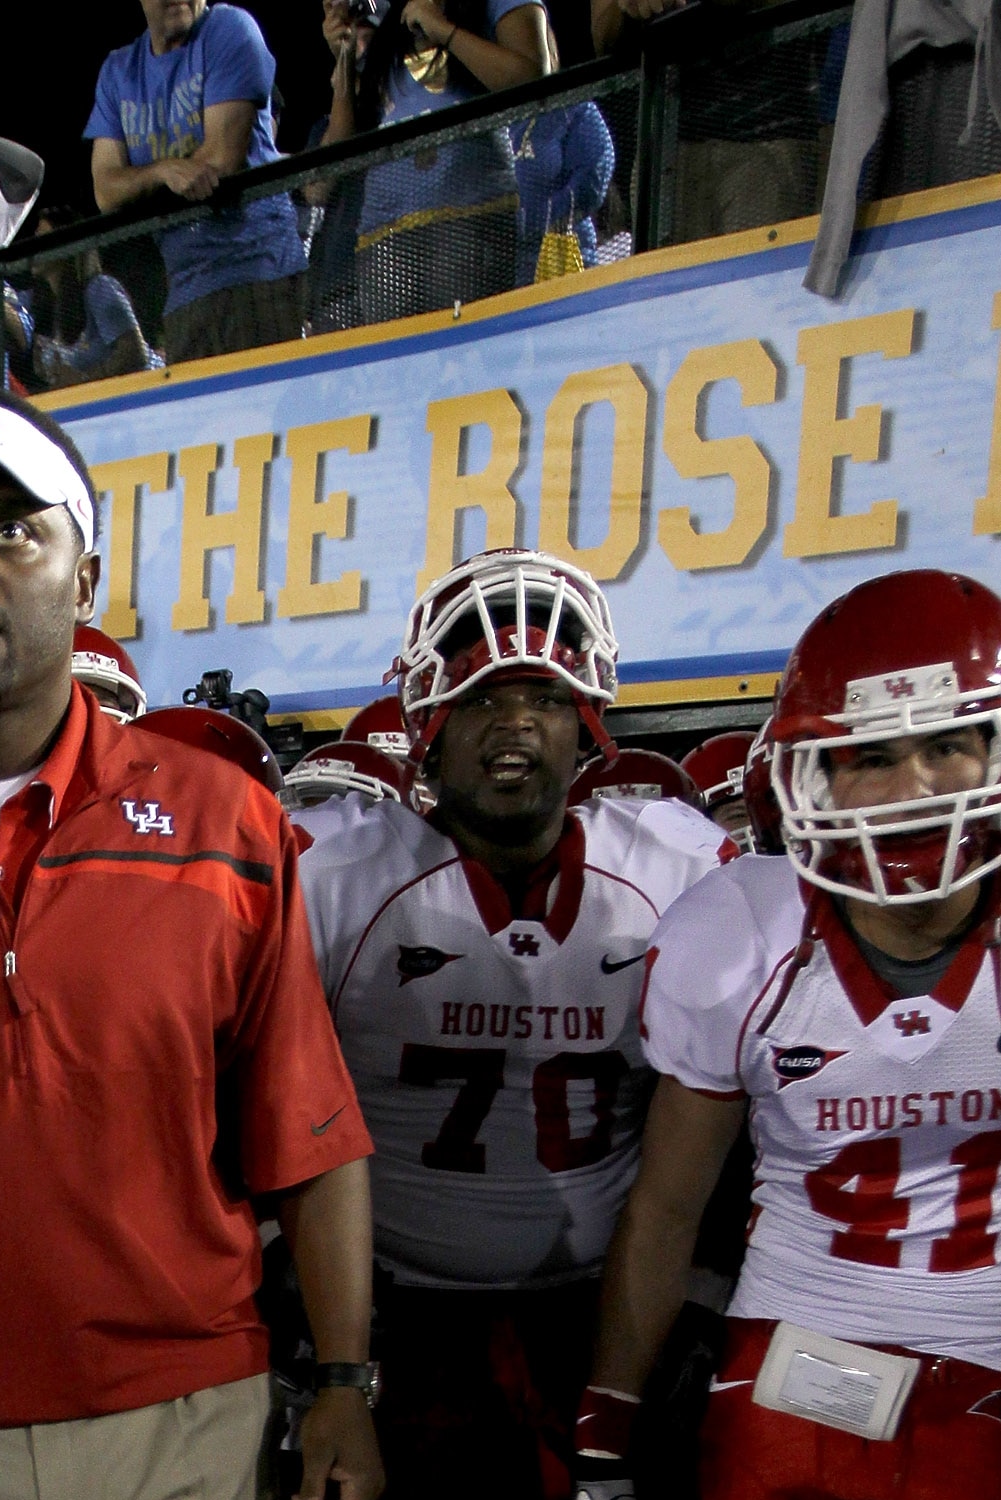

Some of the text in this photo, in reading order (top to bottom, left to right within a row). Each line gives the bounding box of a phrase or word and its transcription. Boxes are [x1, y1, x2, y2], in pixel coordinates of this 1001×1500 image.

[88, 414, 371, 639] THE
[416, 308, 916, 594] ROSE
[120, 798, 175, 836] UH
[440, 1001, 605, 1041] HOUSTON
[399, 1043, 631, 1174] 70
[804, 1130, 1001, 1273] 41
